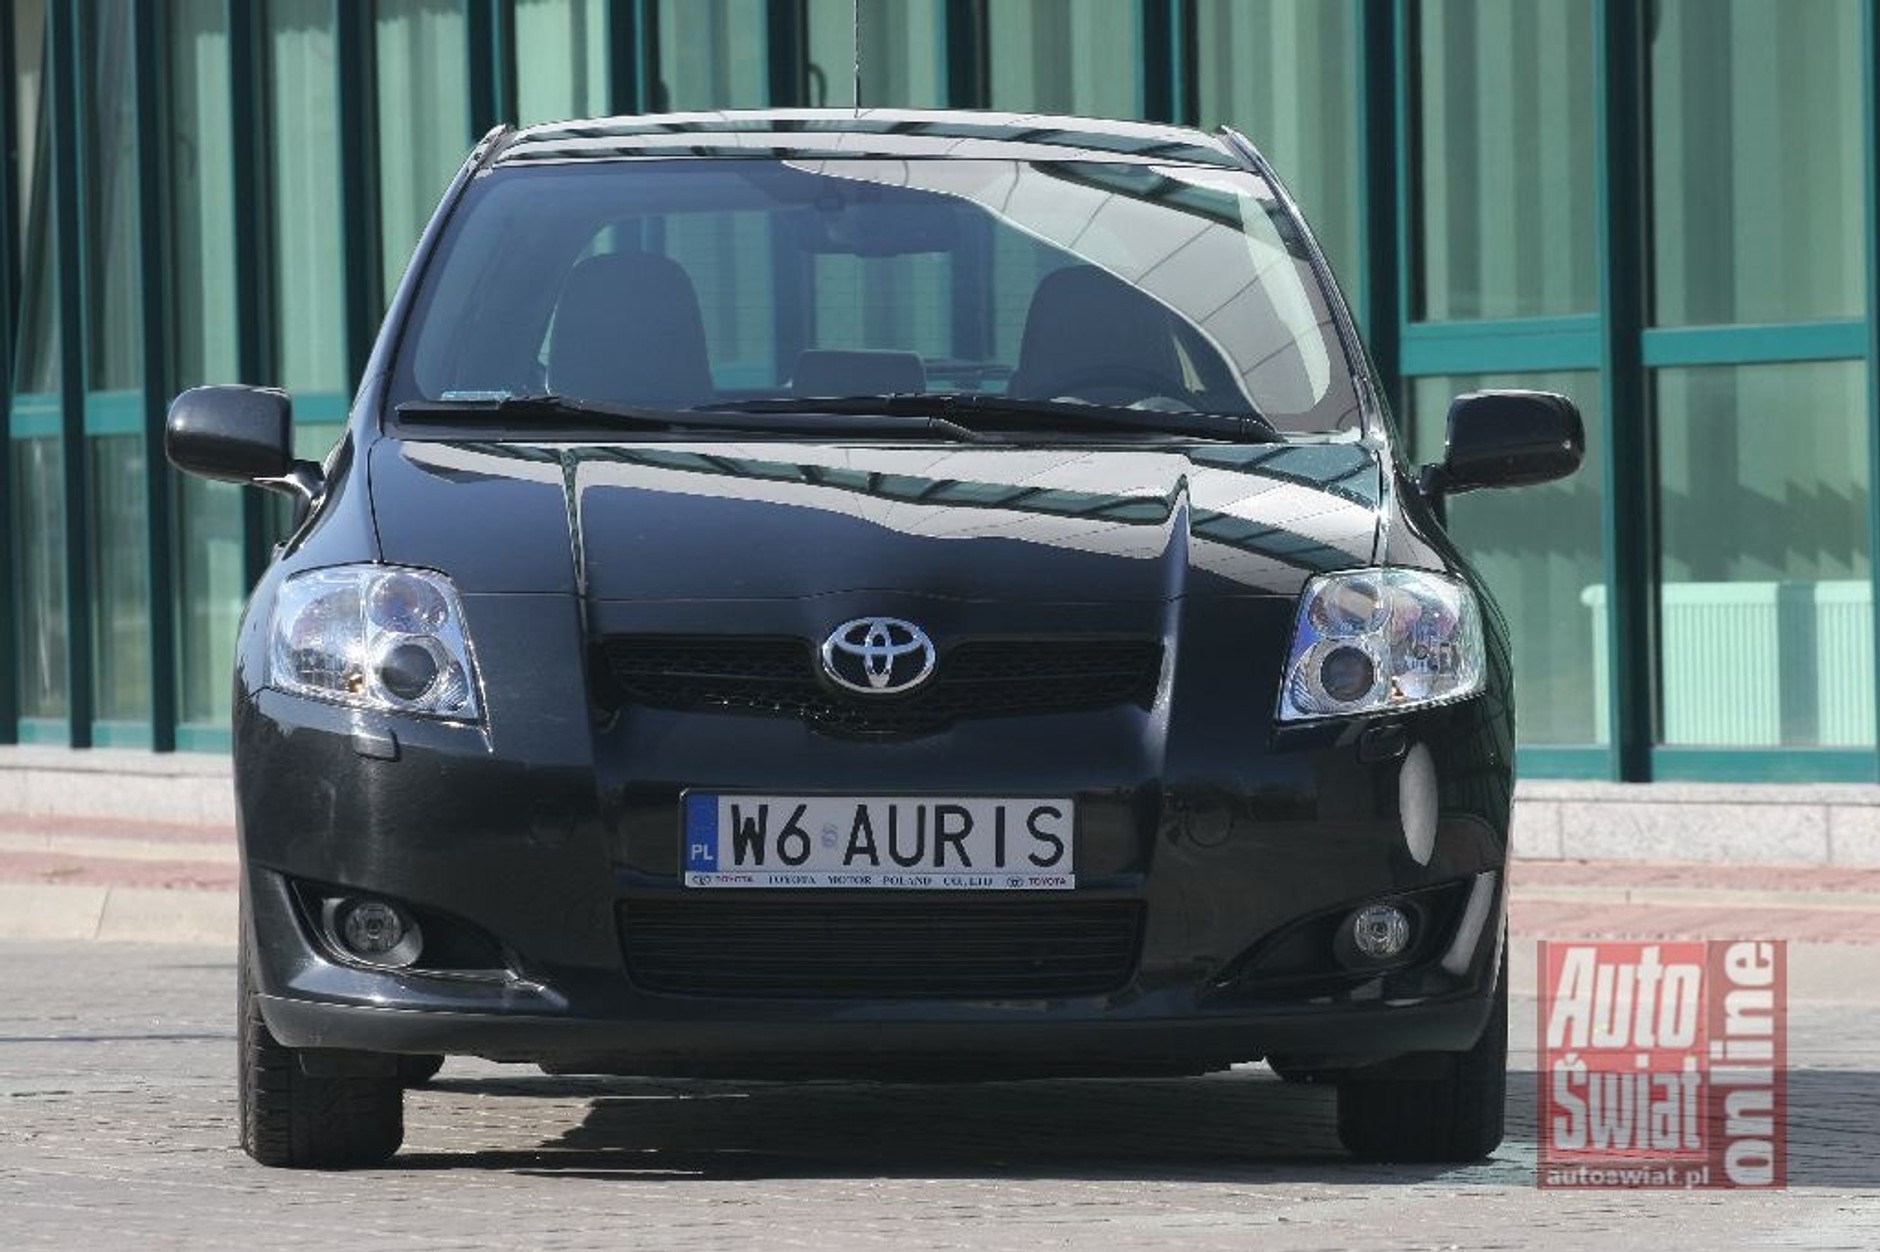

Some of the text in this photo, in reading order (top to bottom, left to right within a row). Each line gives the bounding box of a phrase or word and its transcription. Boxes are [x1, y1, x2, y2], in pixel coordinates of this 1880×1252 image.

[731, 804, 1064, 868] W6 AURIS
[691, 844, 714, 861] PL
[767, 875, 816, 885] TOYOTA
[827, 875, 872, 885] MOTOR
[883, 876, 932, 886] POLAND
[1028, 876, 1066, 887] TOYOTA
